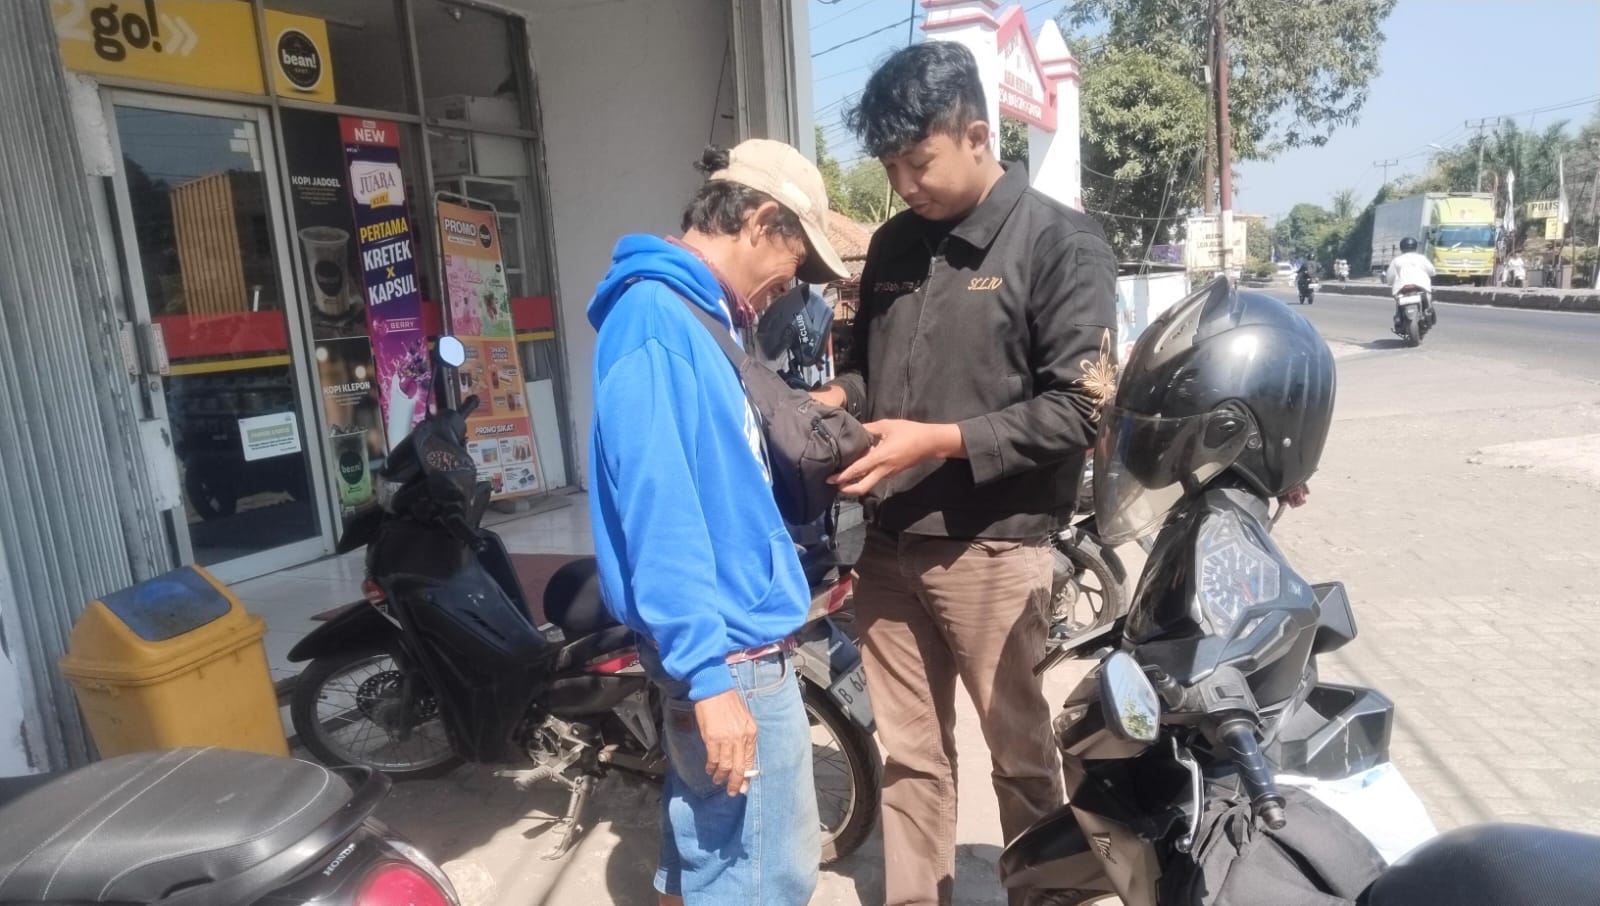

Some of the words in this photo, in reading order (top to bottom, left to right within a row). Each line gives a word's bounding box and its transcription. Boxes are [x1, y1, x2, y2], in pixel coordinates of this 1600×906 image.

[282, 49, 317, 69] bean!
[354, 128, 385, 143] NEW
[291, 175, 311, 185] KOPI
[360, 171, 396, 195] JUARA
[1531, 201, 1560, 211] POLIS
[360, 217, 408, 244] PERTAMA
[444, 218, 477, 237] PROMO
[363, 239, 412, 272] KRETEK
[368, 274, 417, 307] KAPSUL
[390, 320, 414, 329] BERRY
[323, 384, 342, 395] KOPI
[342, 381, 371, 393] KLEPON
[838, 687, 854, 705] B
[322, 843, 357, 876] HONDA
